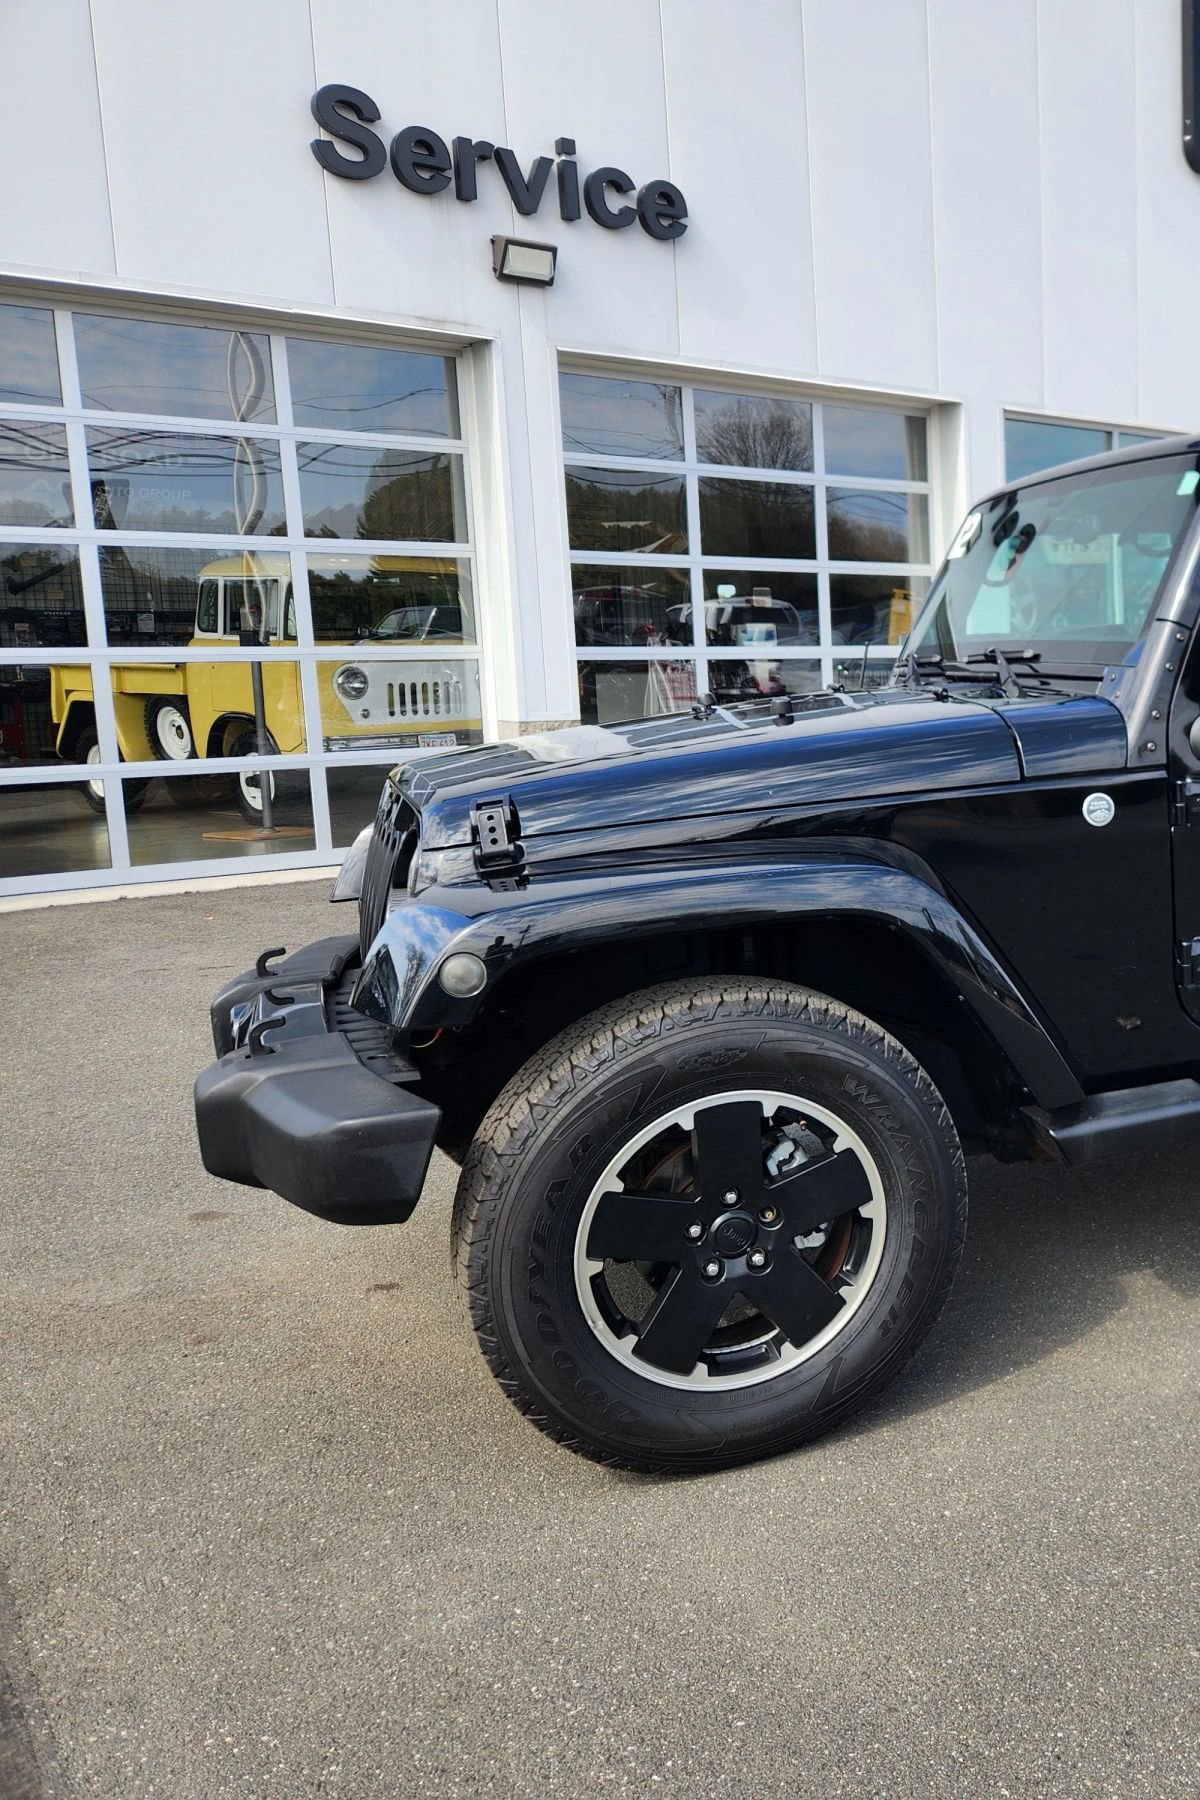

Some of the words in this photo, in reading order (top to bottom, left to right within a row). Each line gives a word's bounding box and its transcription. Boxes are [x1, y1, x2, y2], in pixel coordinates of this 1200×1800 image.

[310, 83, 689, 241] Service
[139, 487, 192, 501] GROUP
[527, 1132, 642, 1424] GOODYEAR
